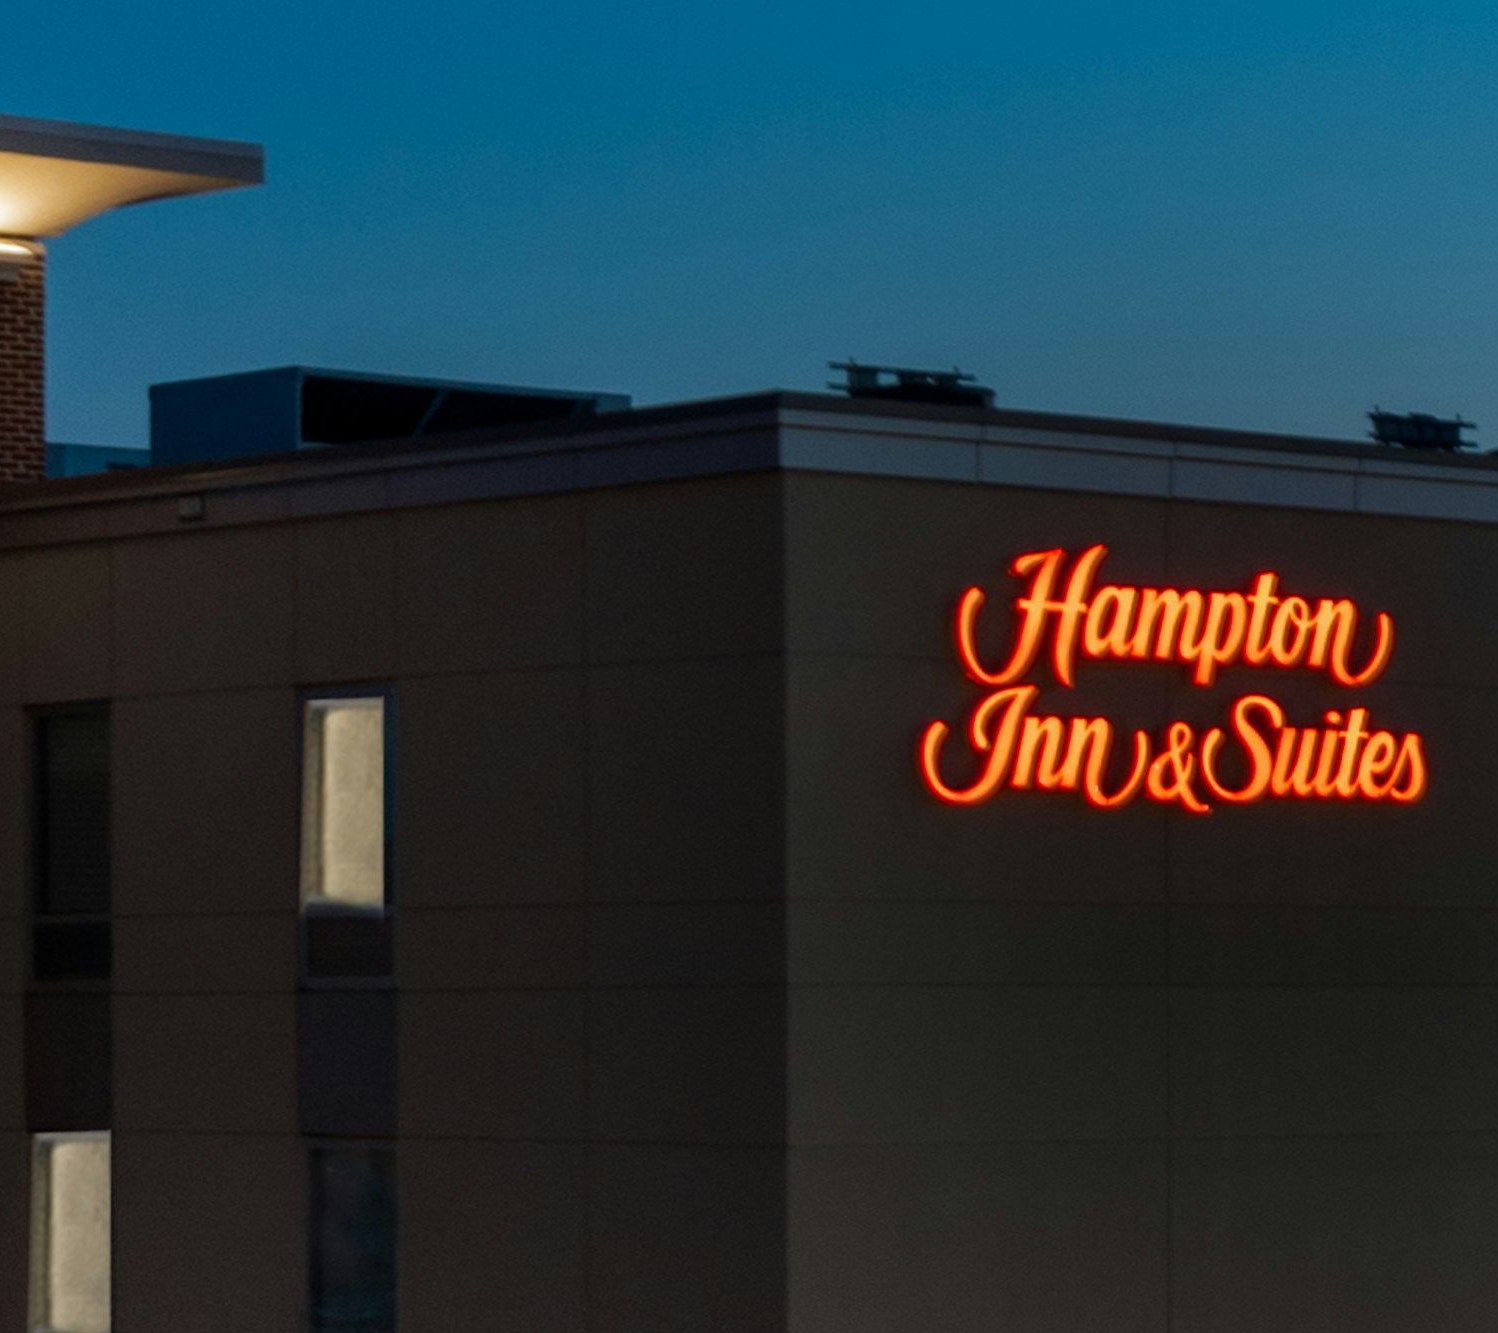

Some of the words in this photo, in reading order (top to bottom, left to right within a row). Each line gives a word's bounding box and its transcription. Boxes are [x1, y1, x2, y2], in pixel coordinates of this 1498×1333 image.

[956, 543, 1395, 688] Hampton
[920, 683, 1152, 807] Inn
[1147, 720, 1212, 813] &
[1201, 693, 1428, 804] Suites
